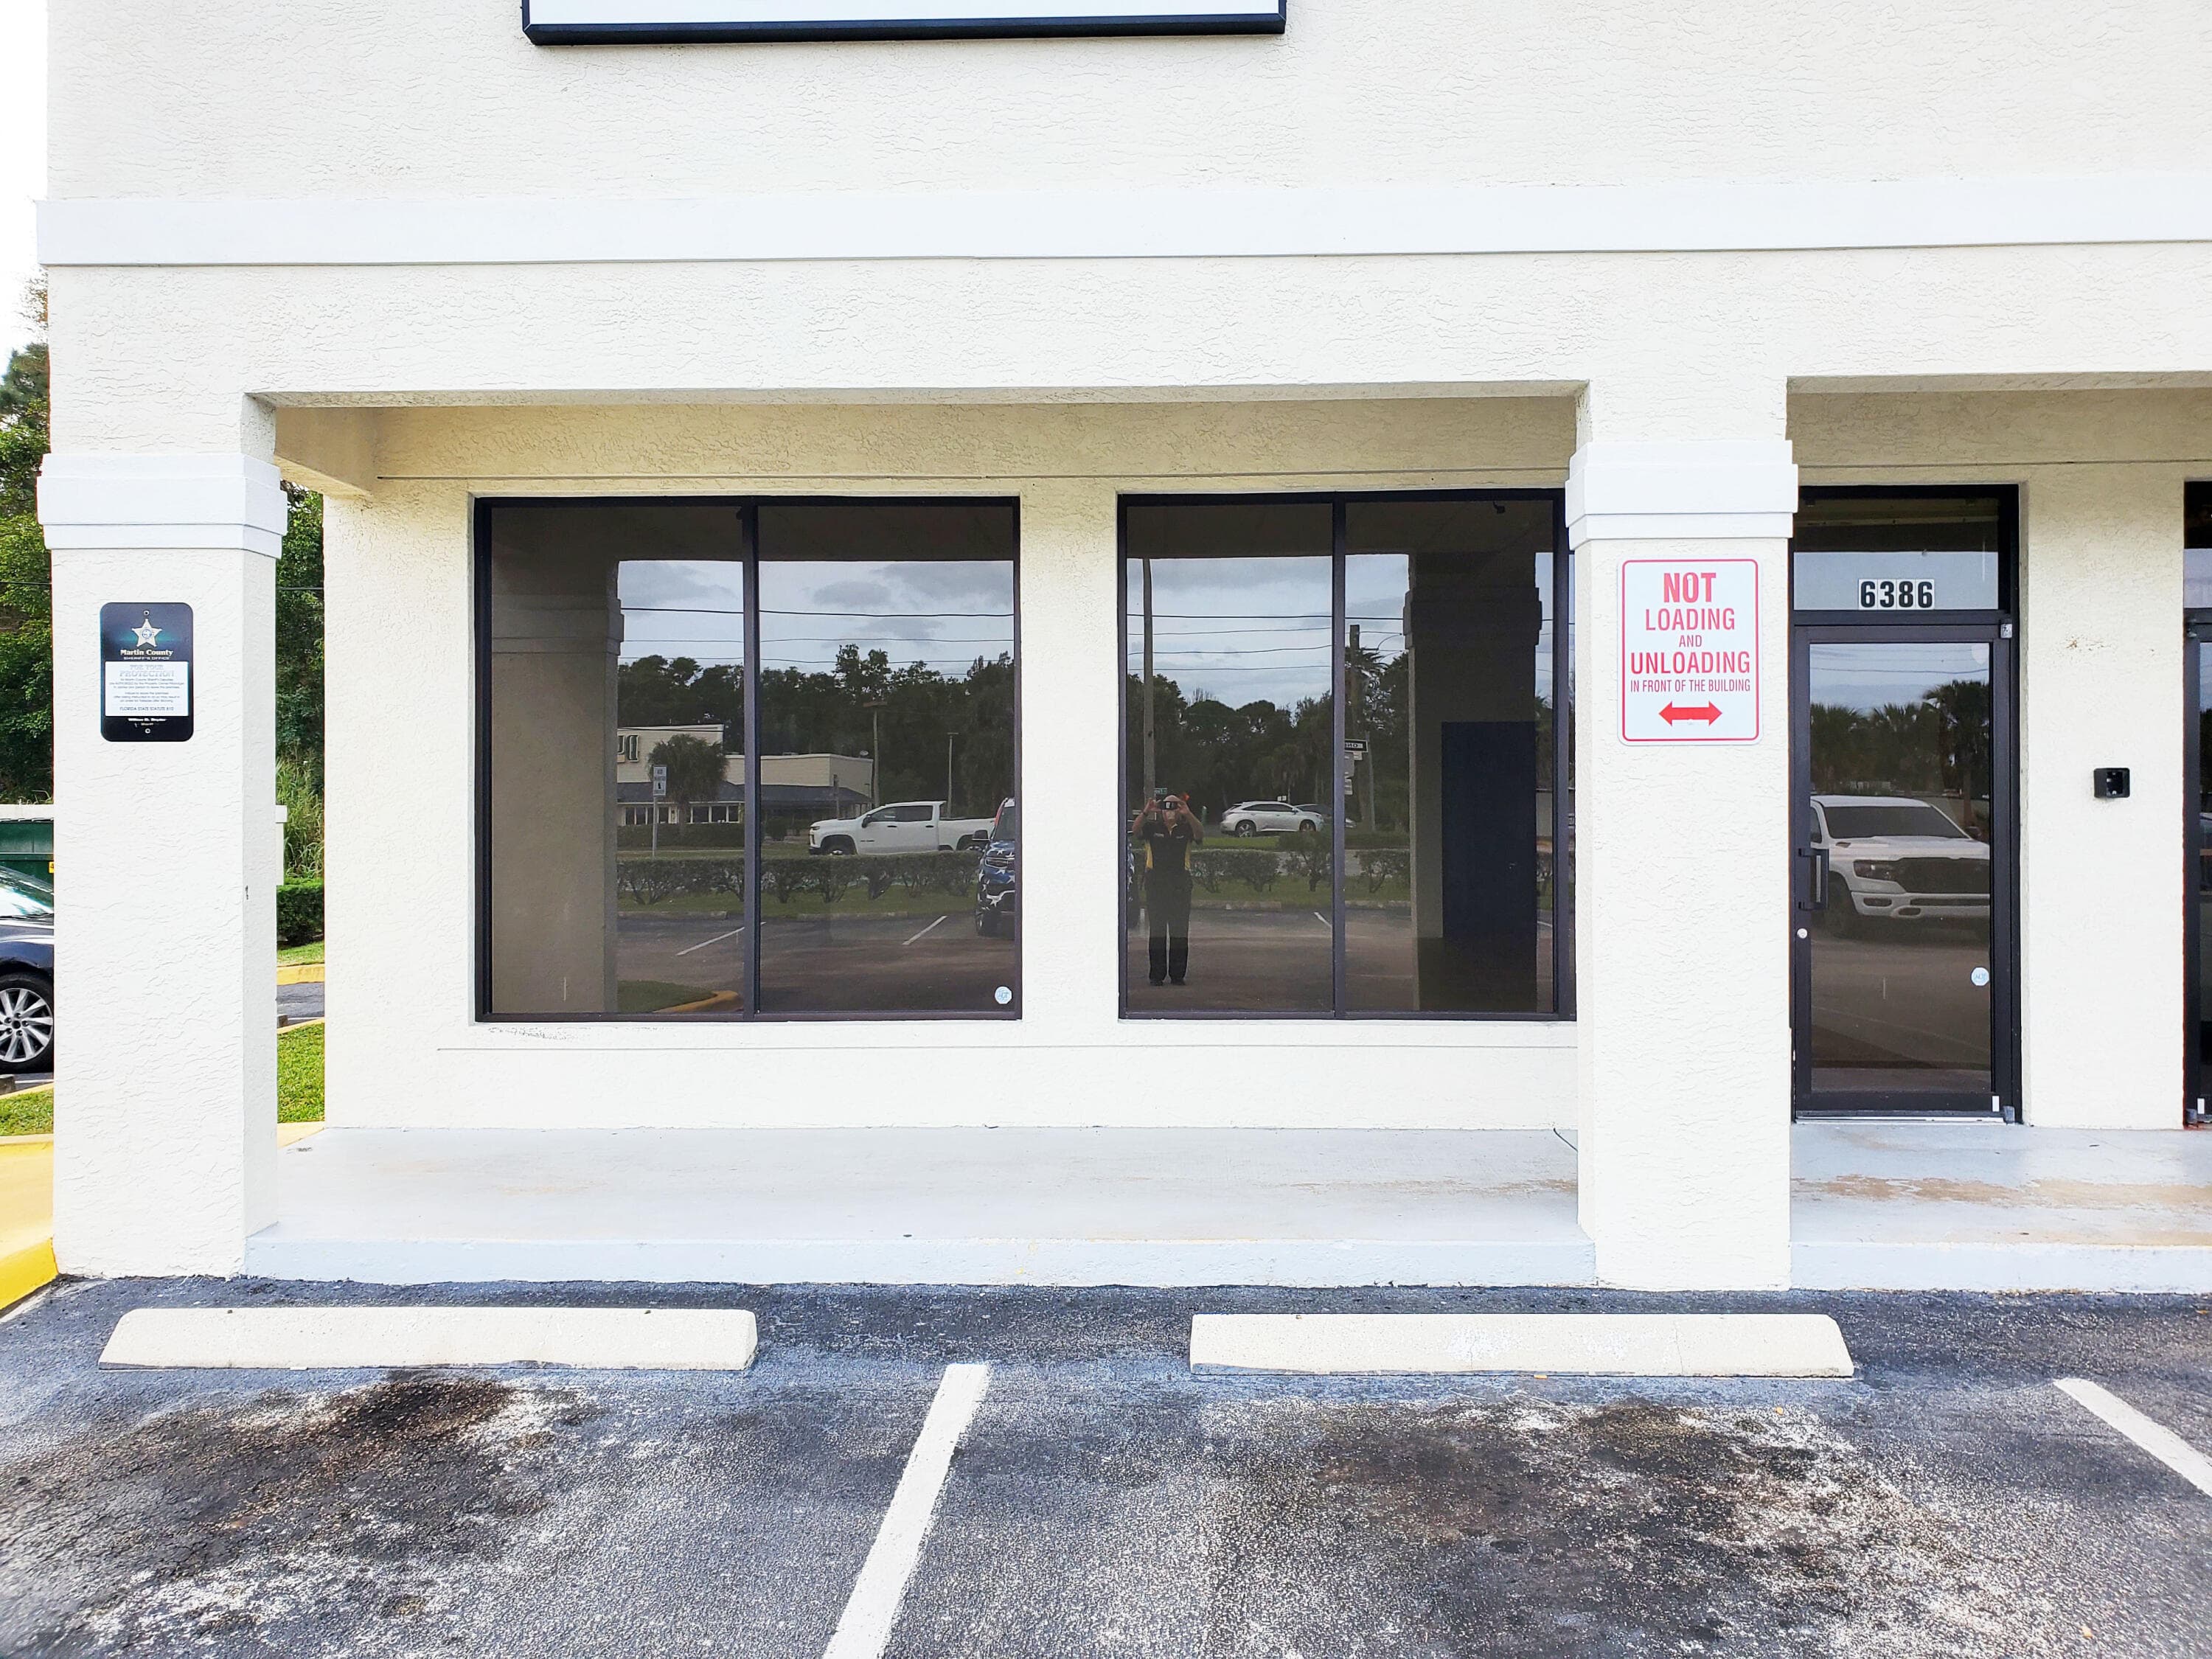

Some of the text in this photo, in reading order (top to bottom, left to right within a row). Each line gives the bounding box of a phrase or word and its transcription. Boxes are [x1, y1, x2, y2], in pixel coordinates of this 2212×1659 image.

[1663, 572, 1717, 603] NOT
[1860, 580, 1933, 608] 6386
[1645, 608, 1735, 630] LOADING
[1679, 635, 1703, 647] AND
[1630, 651, 1750, 675] UNLOADING
[1630, 678, 1750, 692] IN FRONT OF THE BUILDING
